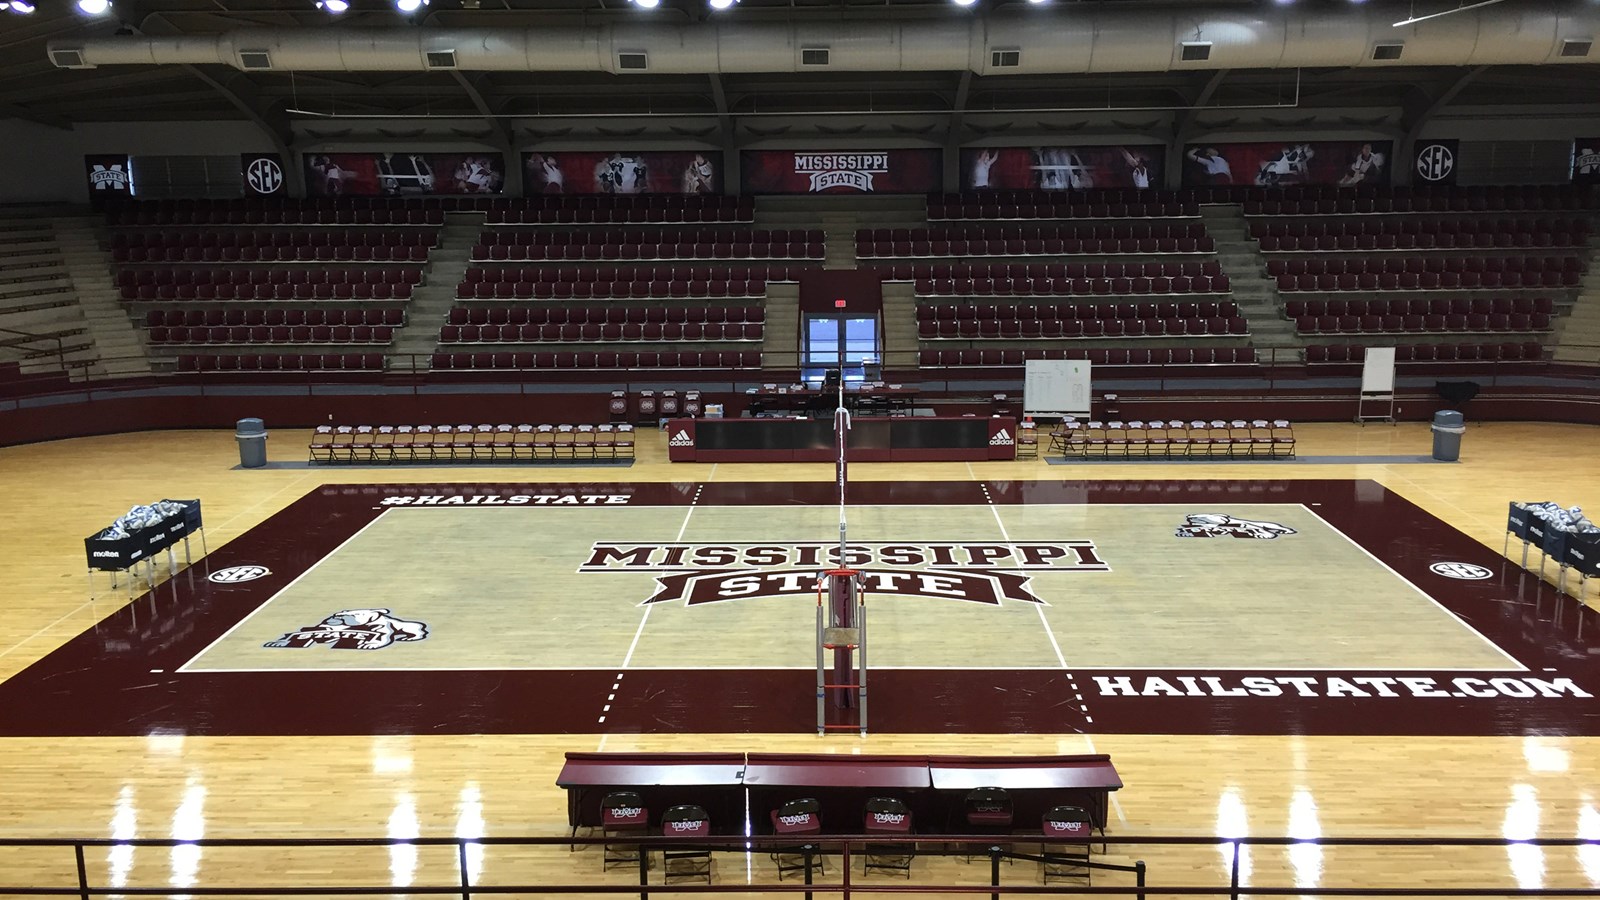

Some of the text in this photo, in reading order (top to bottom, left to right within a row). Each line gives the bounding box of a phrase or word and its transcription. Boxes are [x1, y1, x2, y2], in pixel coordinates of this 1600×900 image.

[795, 155, 888, 169] MISSISSIPPI
[1418, 146, 1453, 180] SEC
[96, 172, 121, 181] STATE
[249, 160, 282, 192] SEC
[820, 173, 862, 186] STATE
[380, 495, 632, 505] #HAILSTATE
[581, 546, 1107, 567] MISSISSIPPI
[717, 574, 967, 596] STTE
[297, 632, 369, 640] STATE
[1091, 676, 1595, 697] HAILSTATE.COM
